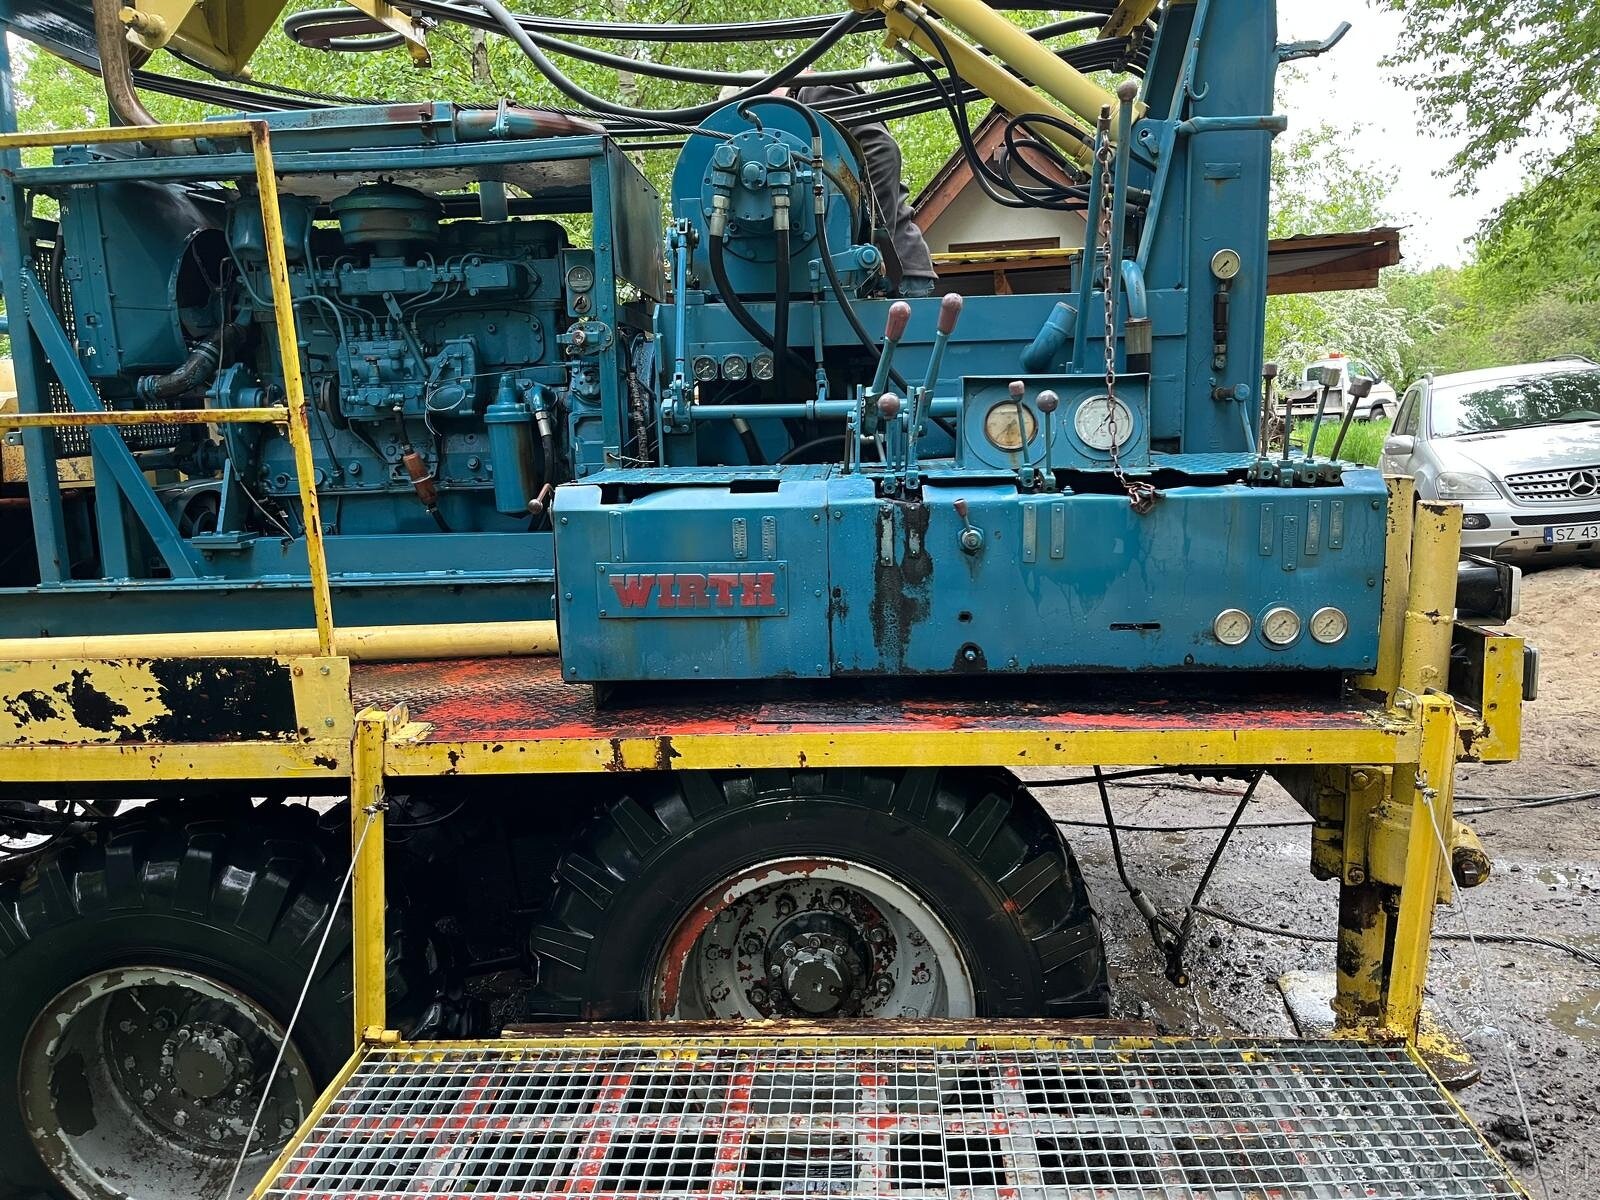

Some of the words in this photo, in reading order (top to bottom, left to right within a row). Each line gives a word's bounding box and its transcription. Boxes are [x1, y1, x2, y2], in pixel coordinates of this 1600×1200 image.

[1556, 527, 1575, 541] SZ
[1581, 525, 1598, 539] 43
[609, 573, 776, 608] WIRTH
